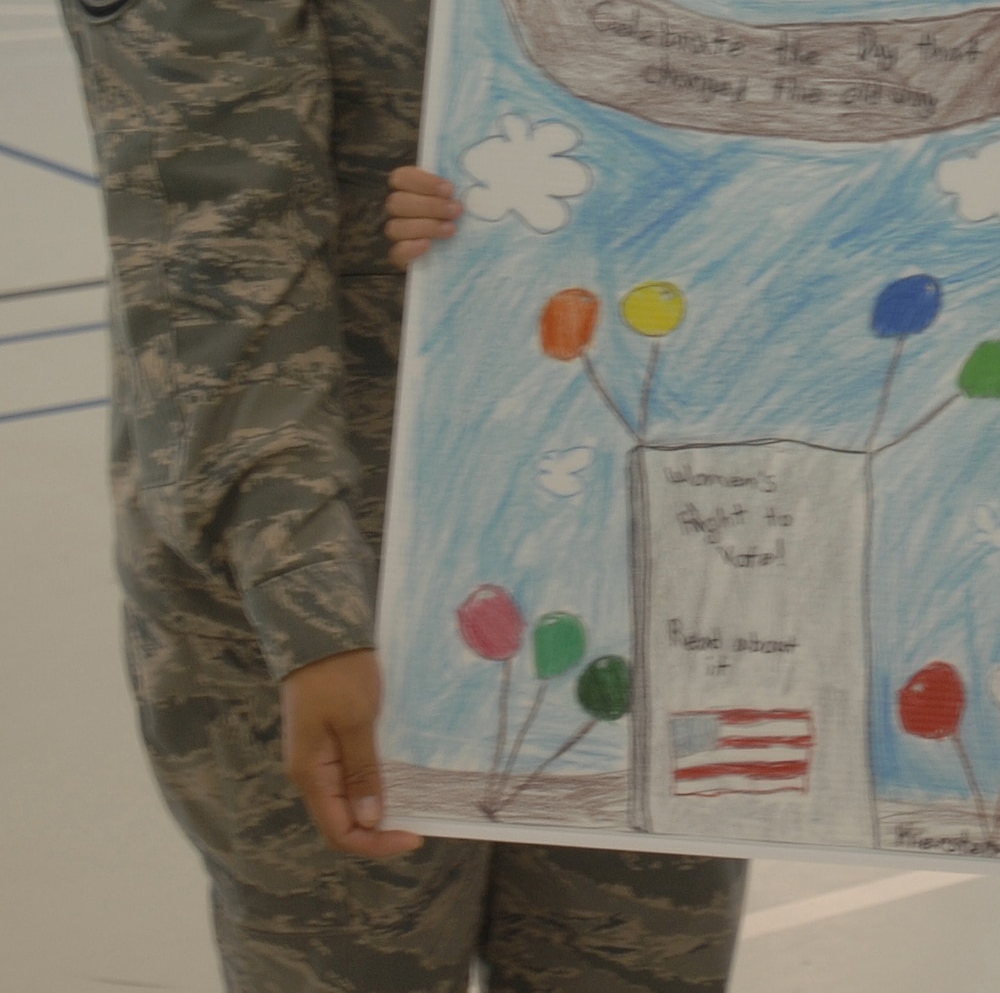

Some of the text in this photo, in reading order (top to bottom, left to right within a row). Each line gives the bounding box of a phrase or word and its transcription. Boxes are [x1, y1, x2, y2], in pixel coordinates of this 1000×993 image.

[772, 31, 820, 66] the
[916, 31, 983, 63] that
[763, 507, 794, 527] to
